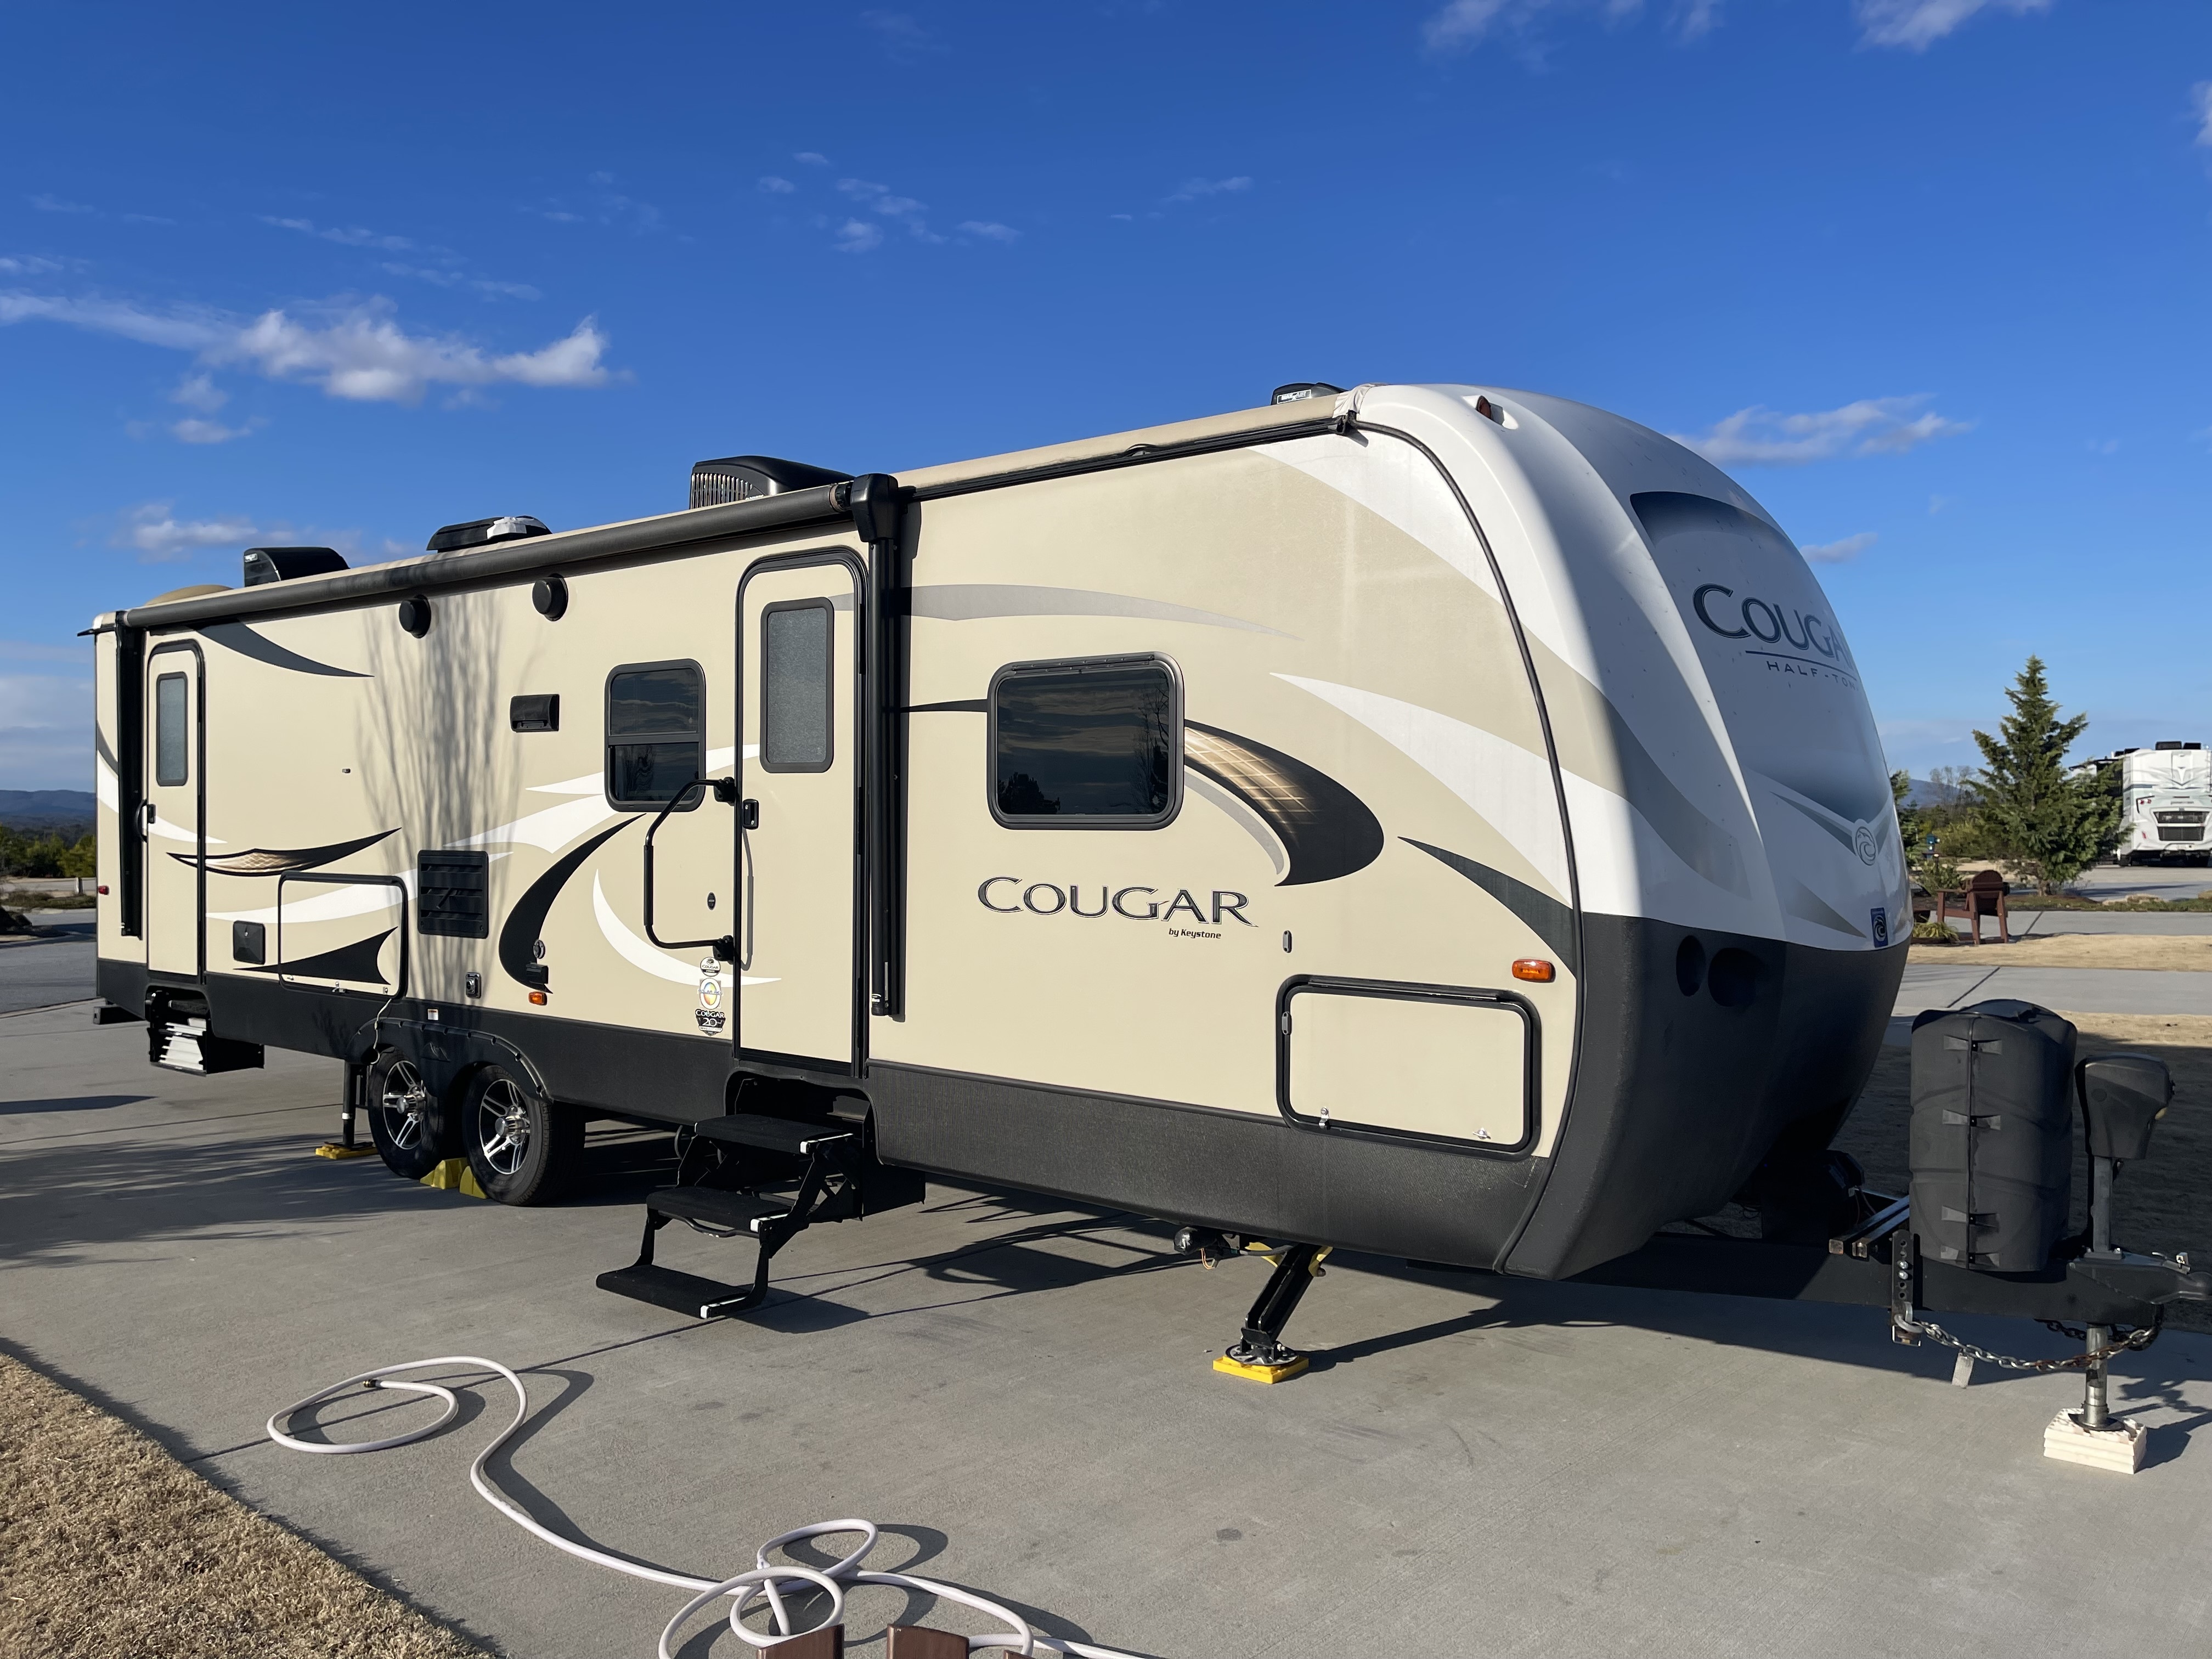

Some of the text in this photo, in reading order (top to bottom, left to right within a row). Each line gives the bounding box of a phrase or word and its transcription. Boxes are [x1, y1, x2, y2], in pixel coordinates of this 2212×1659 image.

[1692, 583, 1855, 671] COUGA
[977, 876, 1258, 927] COUGAR
[1169, 928, 1221, 939] by Keystone
[695, 1009, 724, 1018] COUGAR
